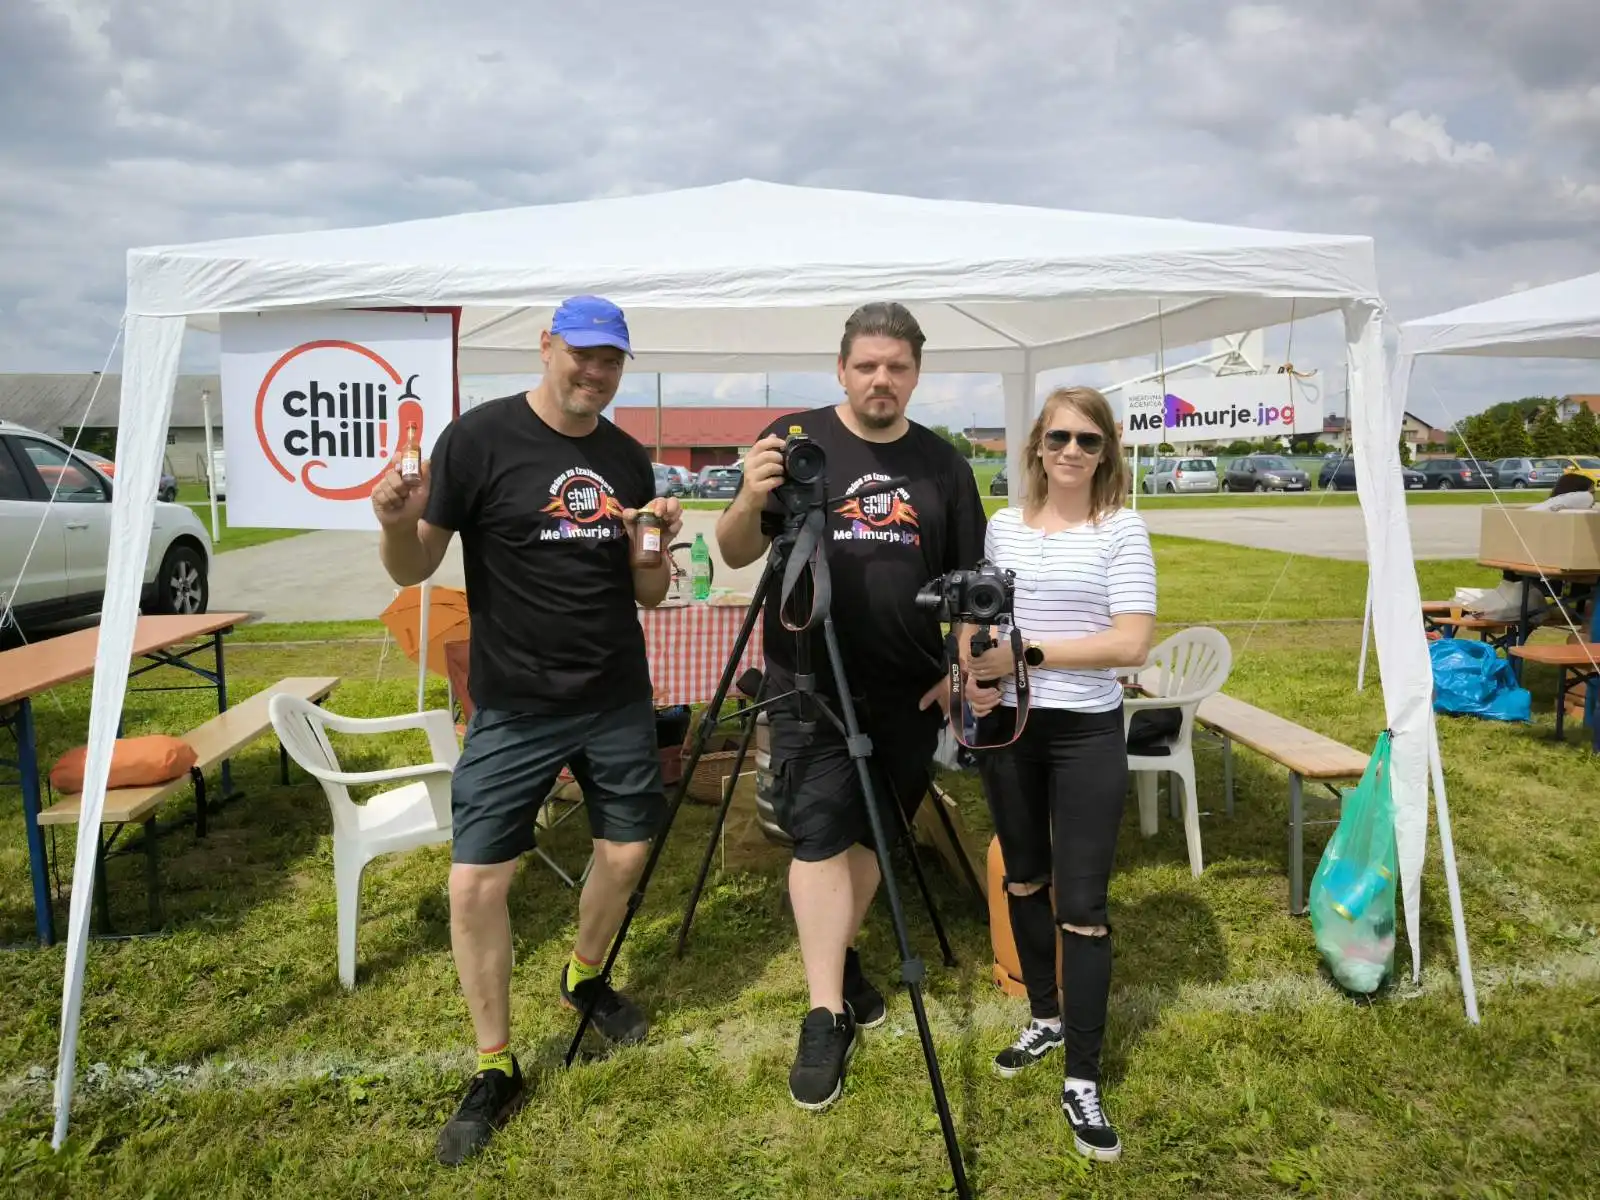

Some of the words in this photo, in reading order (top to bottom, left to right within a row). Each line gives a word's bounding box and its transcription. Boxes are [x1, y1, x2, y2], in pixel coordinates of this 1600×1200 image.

[282, 380, 387, 420] chilli
[283, 420, 388, 459] chill!
[567, 487, 598, 500] chilli
[1018, 660, 1026, 689] Canon
